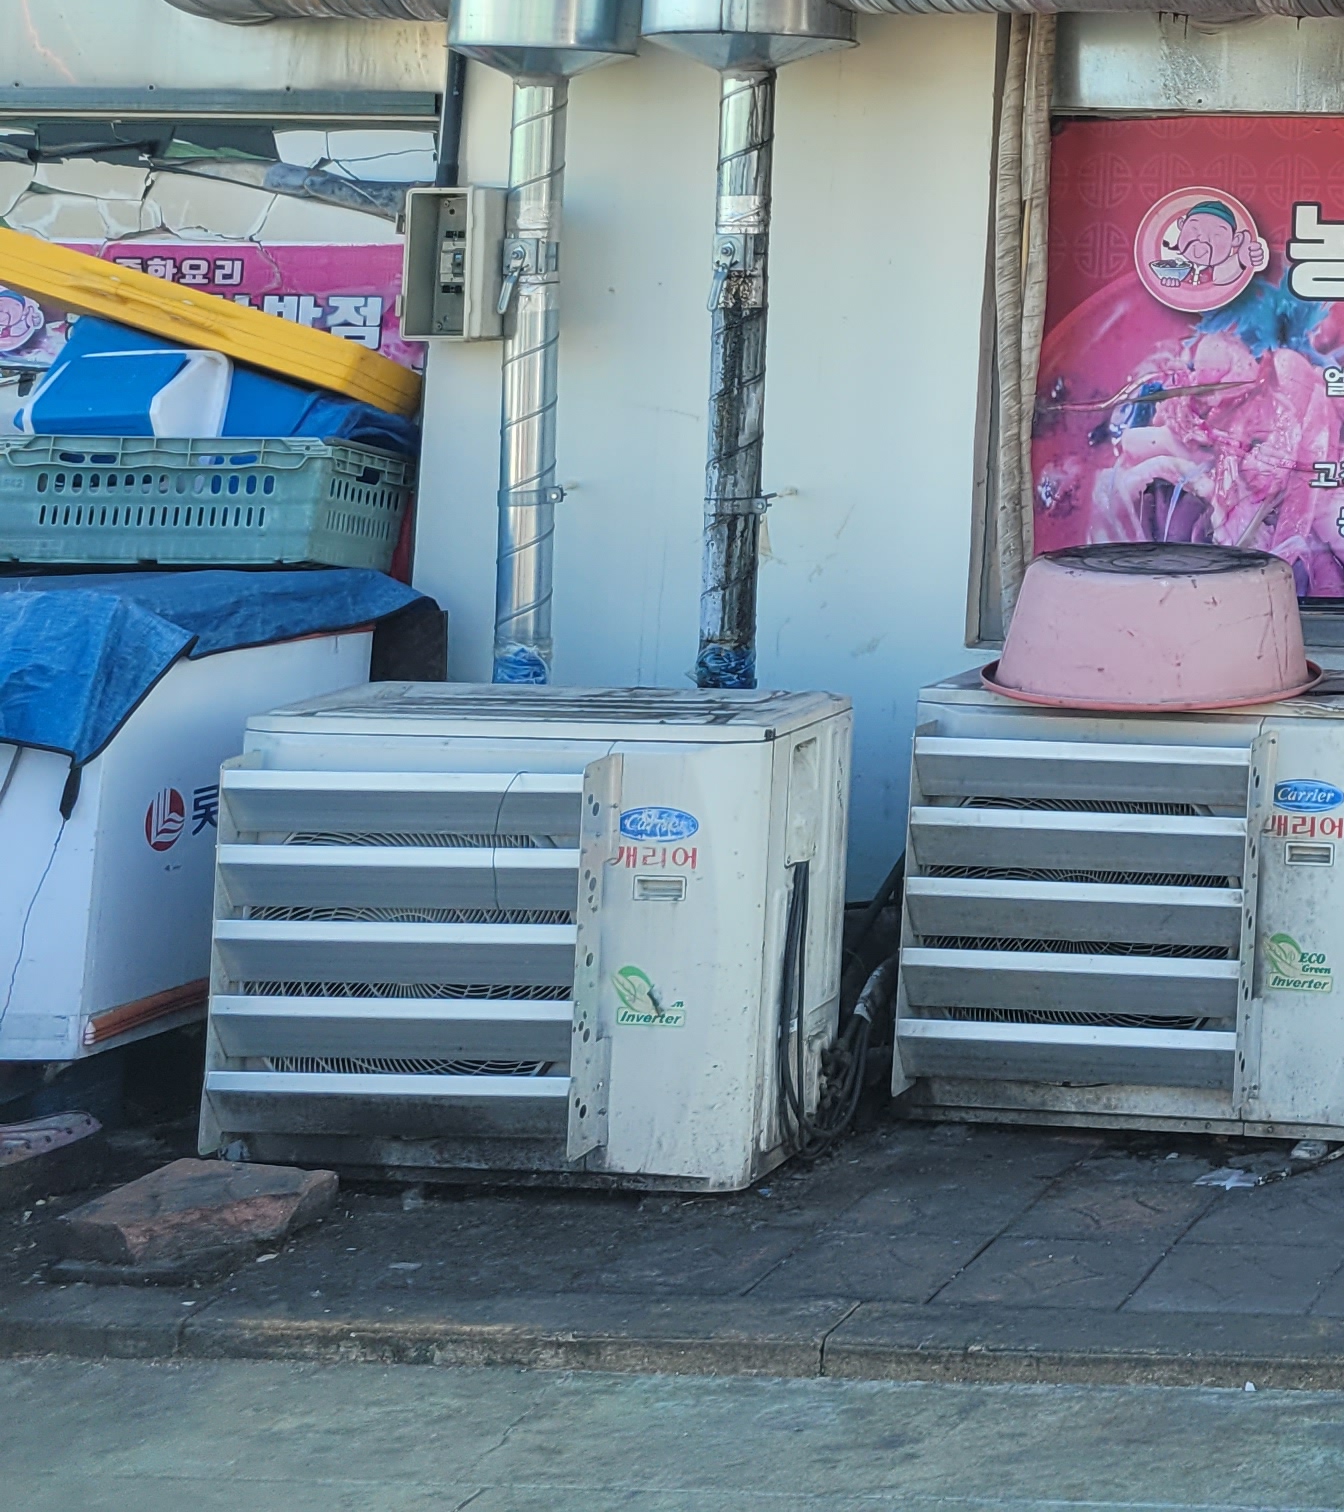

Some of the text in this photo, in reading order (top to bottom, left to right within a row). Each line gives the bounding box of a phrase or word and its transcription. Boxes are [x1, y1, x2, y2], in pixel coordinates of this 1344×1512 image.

[1276, 786, 1335, 804] Carrier
[1299, 952, 1326, 964] ECO
[1271, 975, 1330, 990] Inverter
[620, 1009, 682, 1027] Inverter
